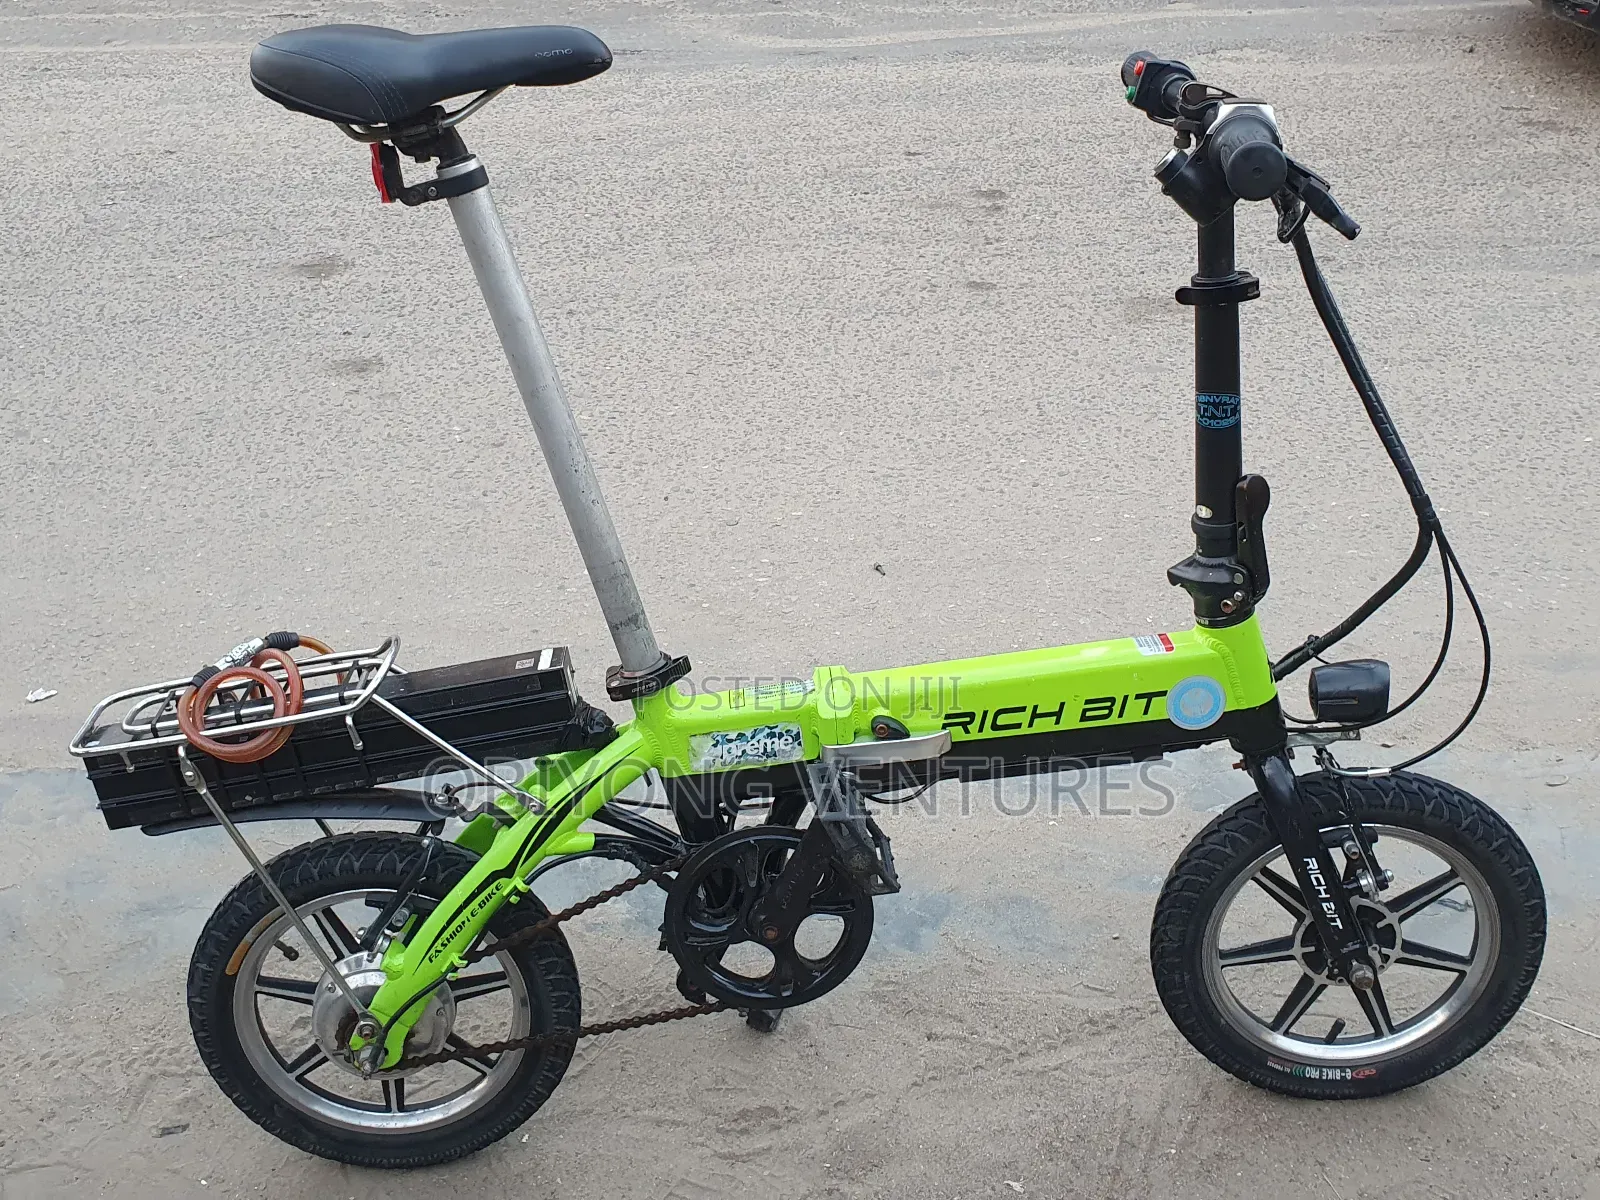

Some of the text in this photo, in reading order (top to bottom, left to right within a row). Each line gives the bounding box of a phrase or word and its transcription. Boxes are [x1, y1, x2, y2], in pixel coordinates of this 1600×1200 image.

[941, 702, 1065, 735] RICH
[1079, 690, 1168, 722] BIT
[709, 733, 794, 760] preme
[1303, 858, 1343, 930] RICH BIT
[1305, 1066, 1319, 1080] PRO
[1322, 1067, 1352, 1080] e-BIKE
